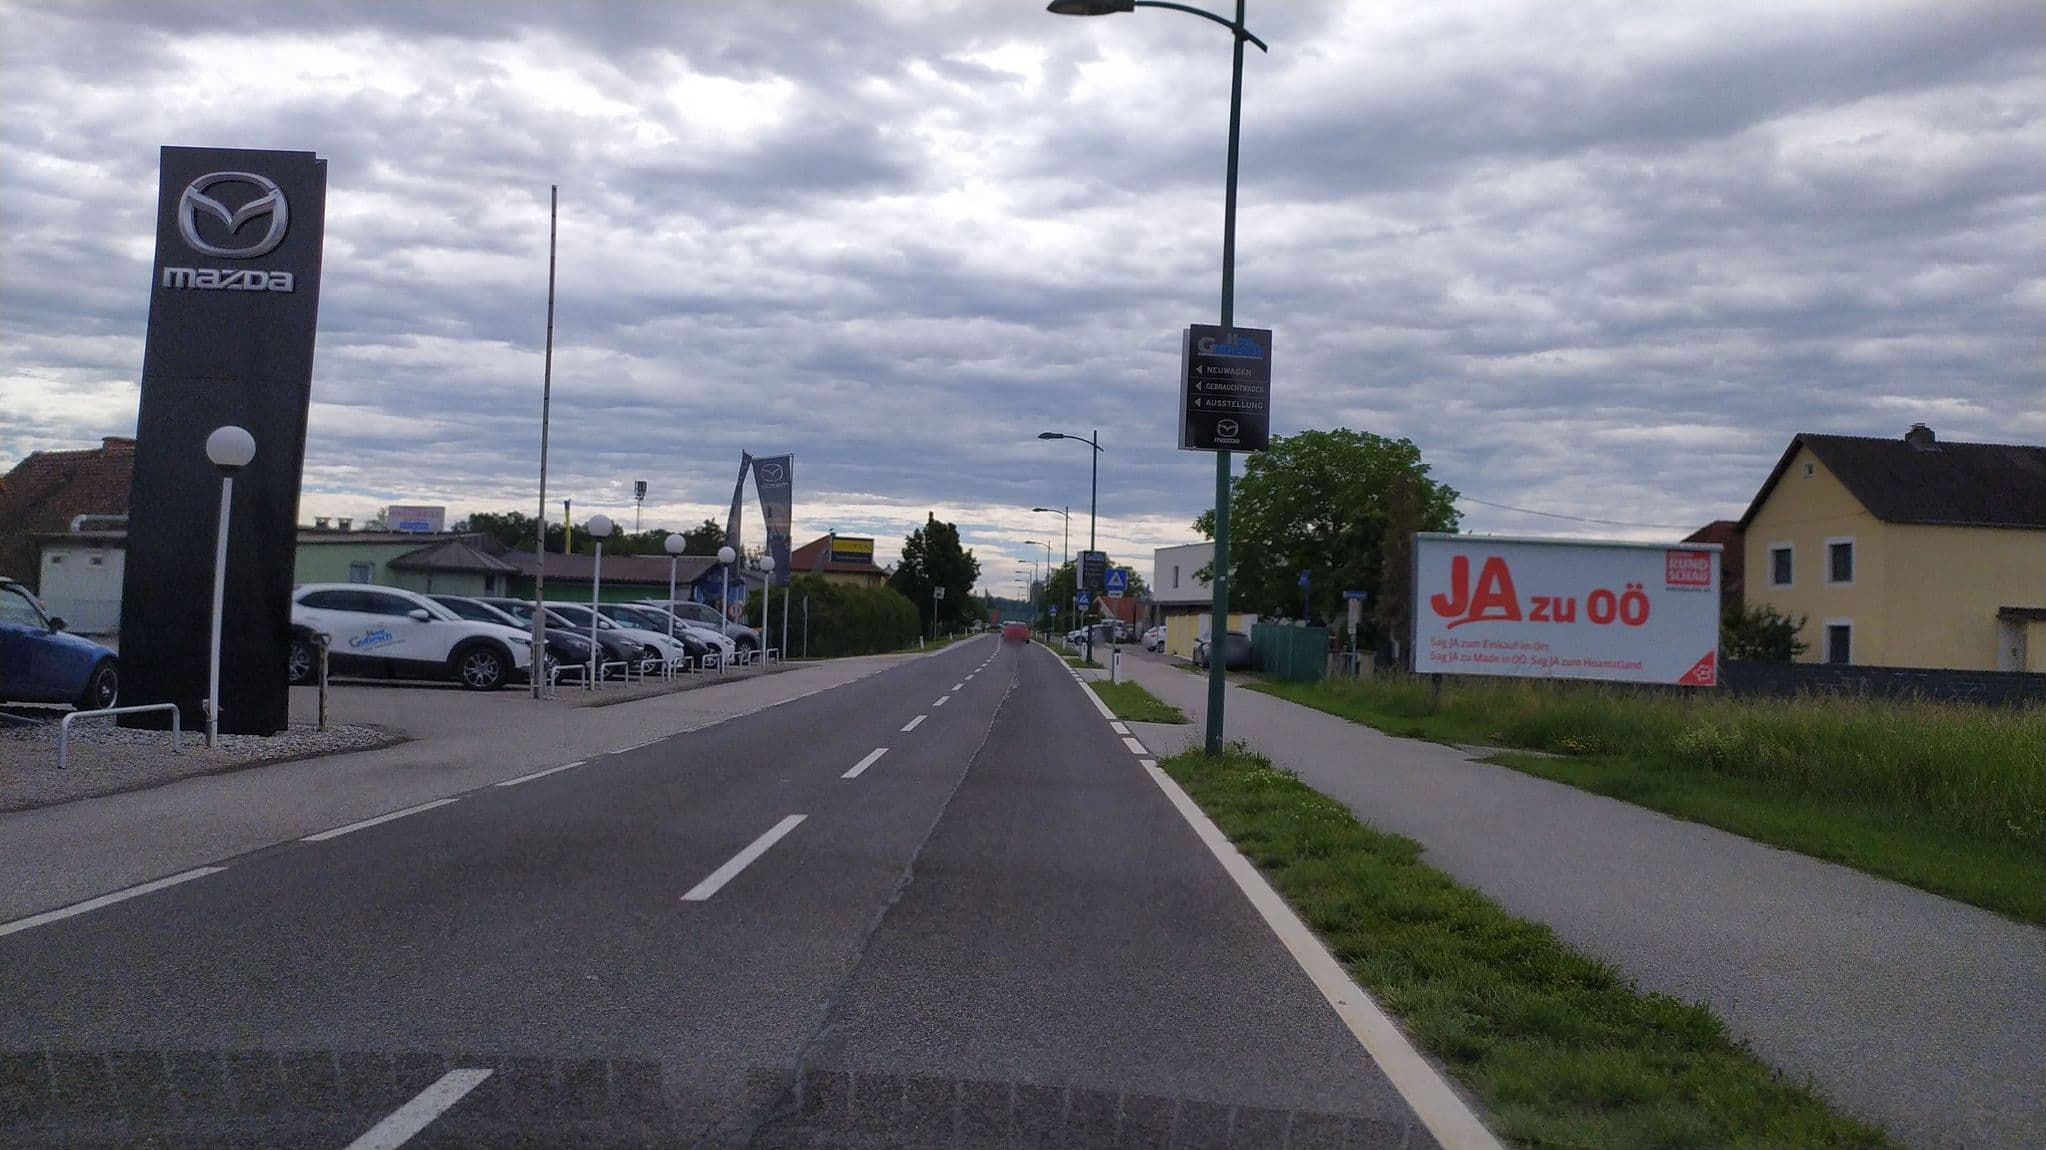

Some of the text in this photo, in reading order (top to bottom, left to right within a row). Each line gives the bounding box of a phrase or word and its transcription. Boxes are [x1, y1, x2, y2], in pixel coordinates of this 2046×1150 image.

[162, 267, 294, 292] mazda
[1206, 366, 1252, 376] NEUWAGEN
[1206, 382, 1265, 393] GEBRAUCHTWAGEN
[1205, 399, 1264, 409] AUSSTELLUNG
[1430, 555, 1650, 627] JA zu OÖ
